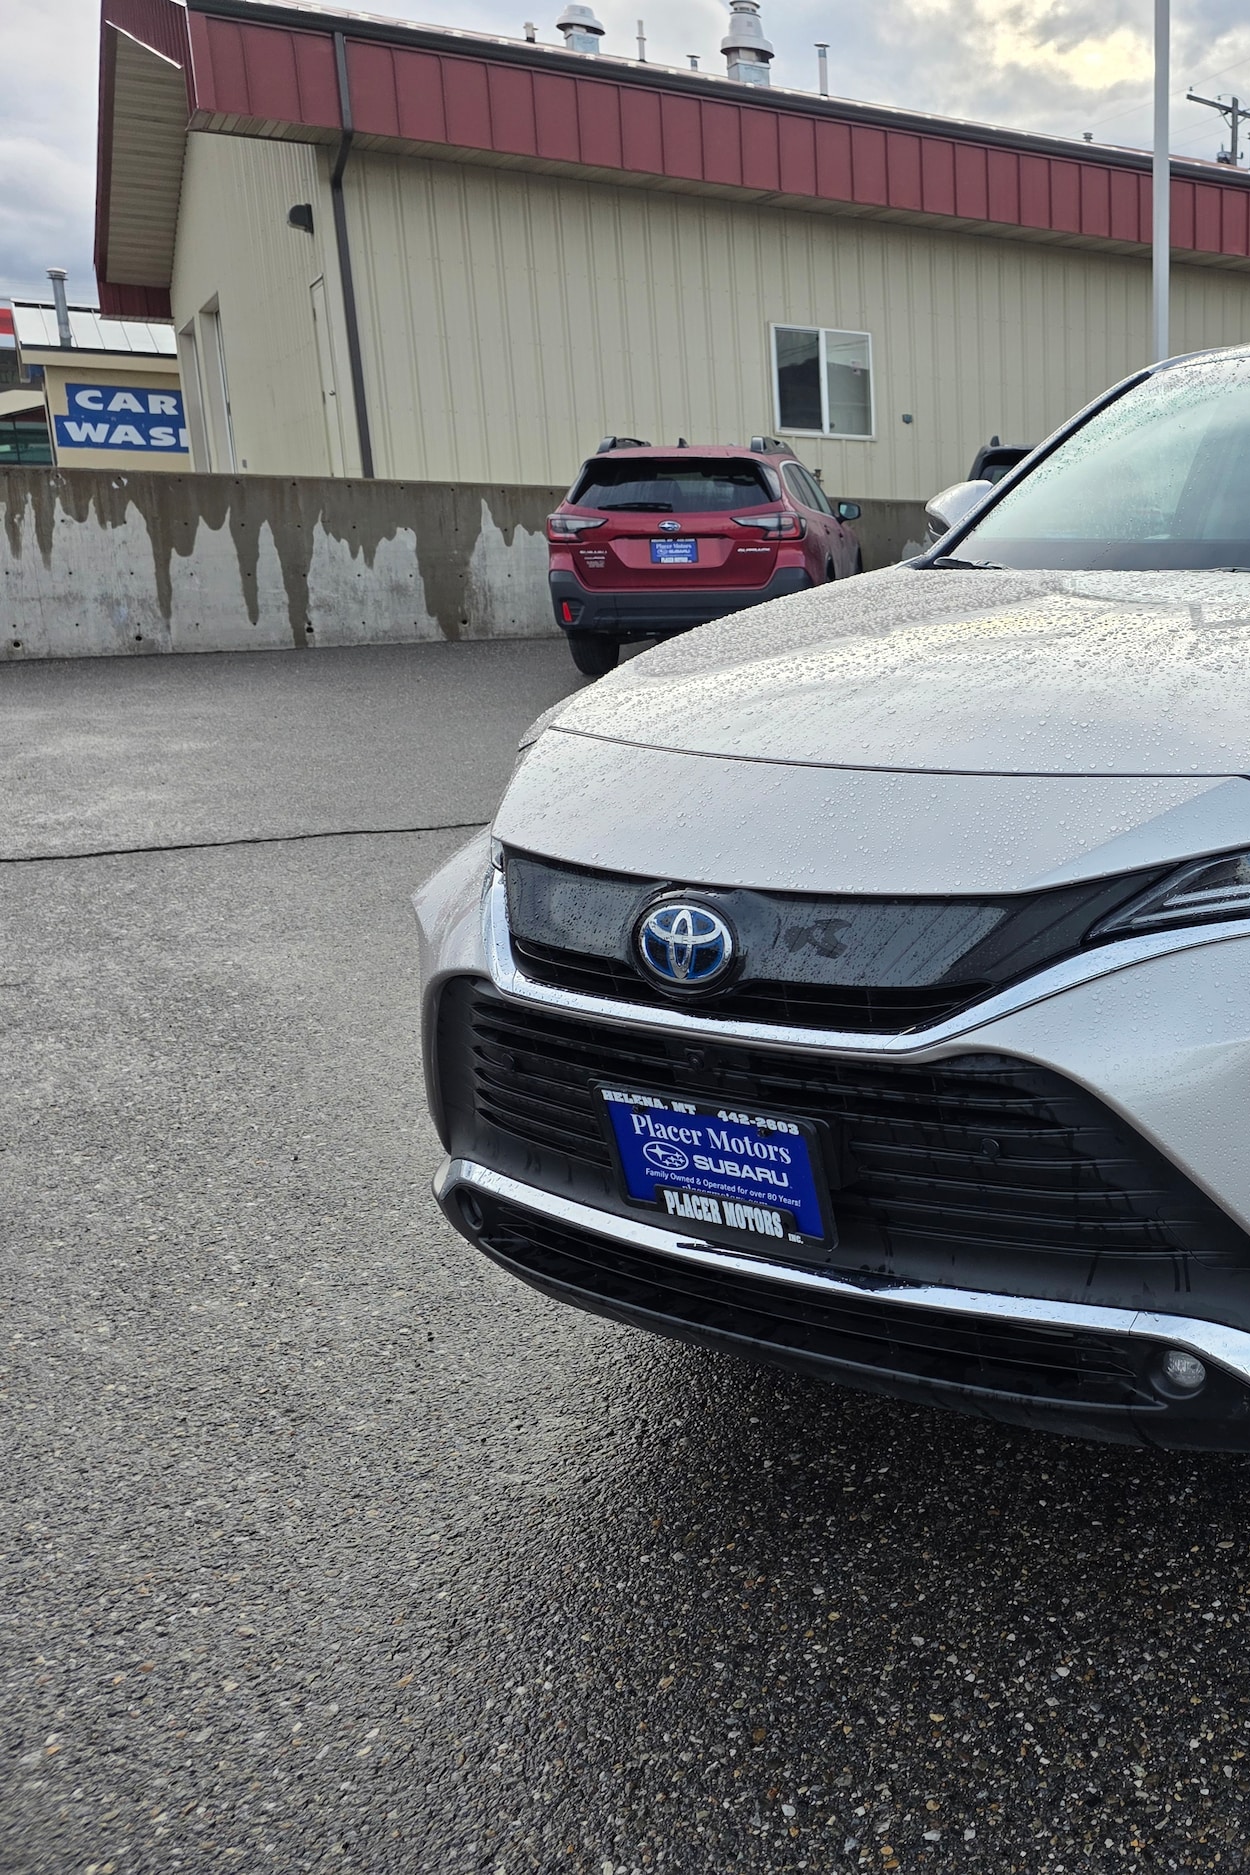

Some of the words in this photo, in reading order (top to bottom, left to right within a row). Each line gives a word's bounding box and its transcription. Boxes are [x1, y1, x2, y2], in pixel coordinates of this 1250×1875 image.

[75, 390, 179, 415] CAR
[671, 1101, 696, 1115] MT
[717, 1110, 799, 1136] 442-2603
[630, 1113, 702, 1146] Placer
[706, 1127, 792, 1165] Motors
[693, 1154, 790, 1188] SUBARU
[645, 1167, 669, 1180] Family
[670, 1172, 695, 1184] Owned
[696, 1177, 702, 1186] &
[702, 1179, 736, 1193] Operated
[737, 1186, 748, 1195] for
[749, 1189, 766, 1199] over
[767, 1192, 777, 1201] 80
[778, 1194, 801, 1208] Years!
[663, 1189, 723, 1225] PLACER
[722, 1200, 784, 1239] MOTORS
[787, 1233, 804, 1244] INC.
